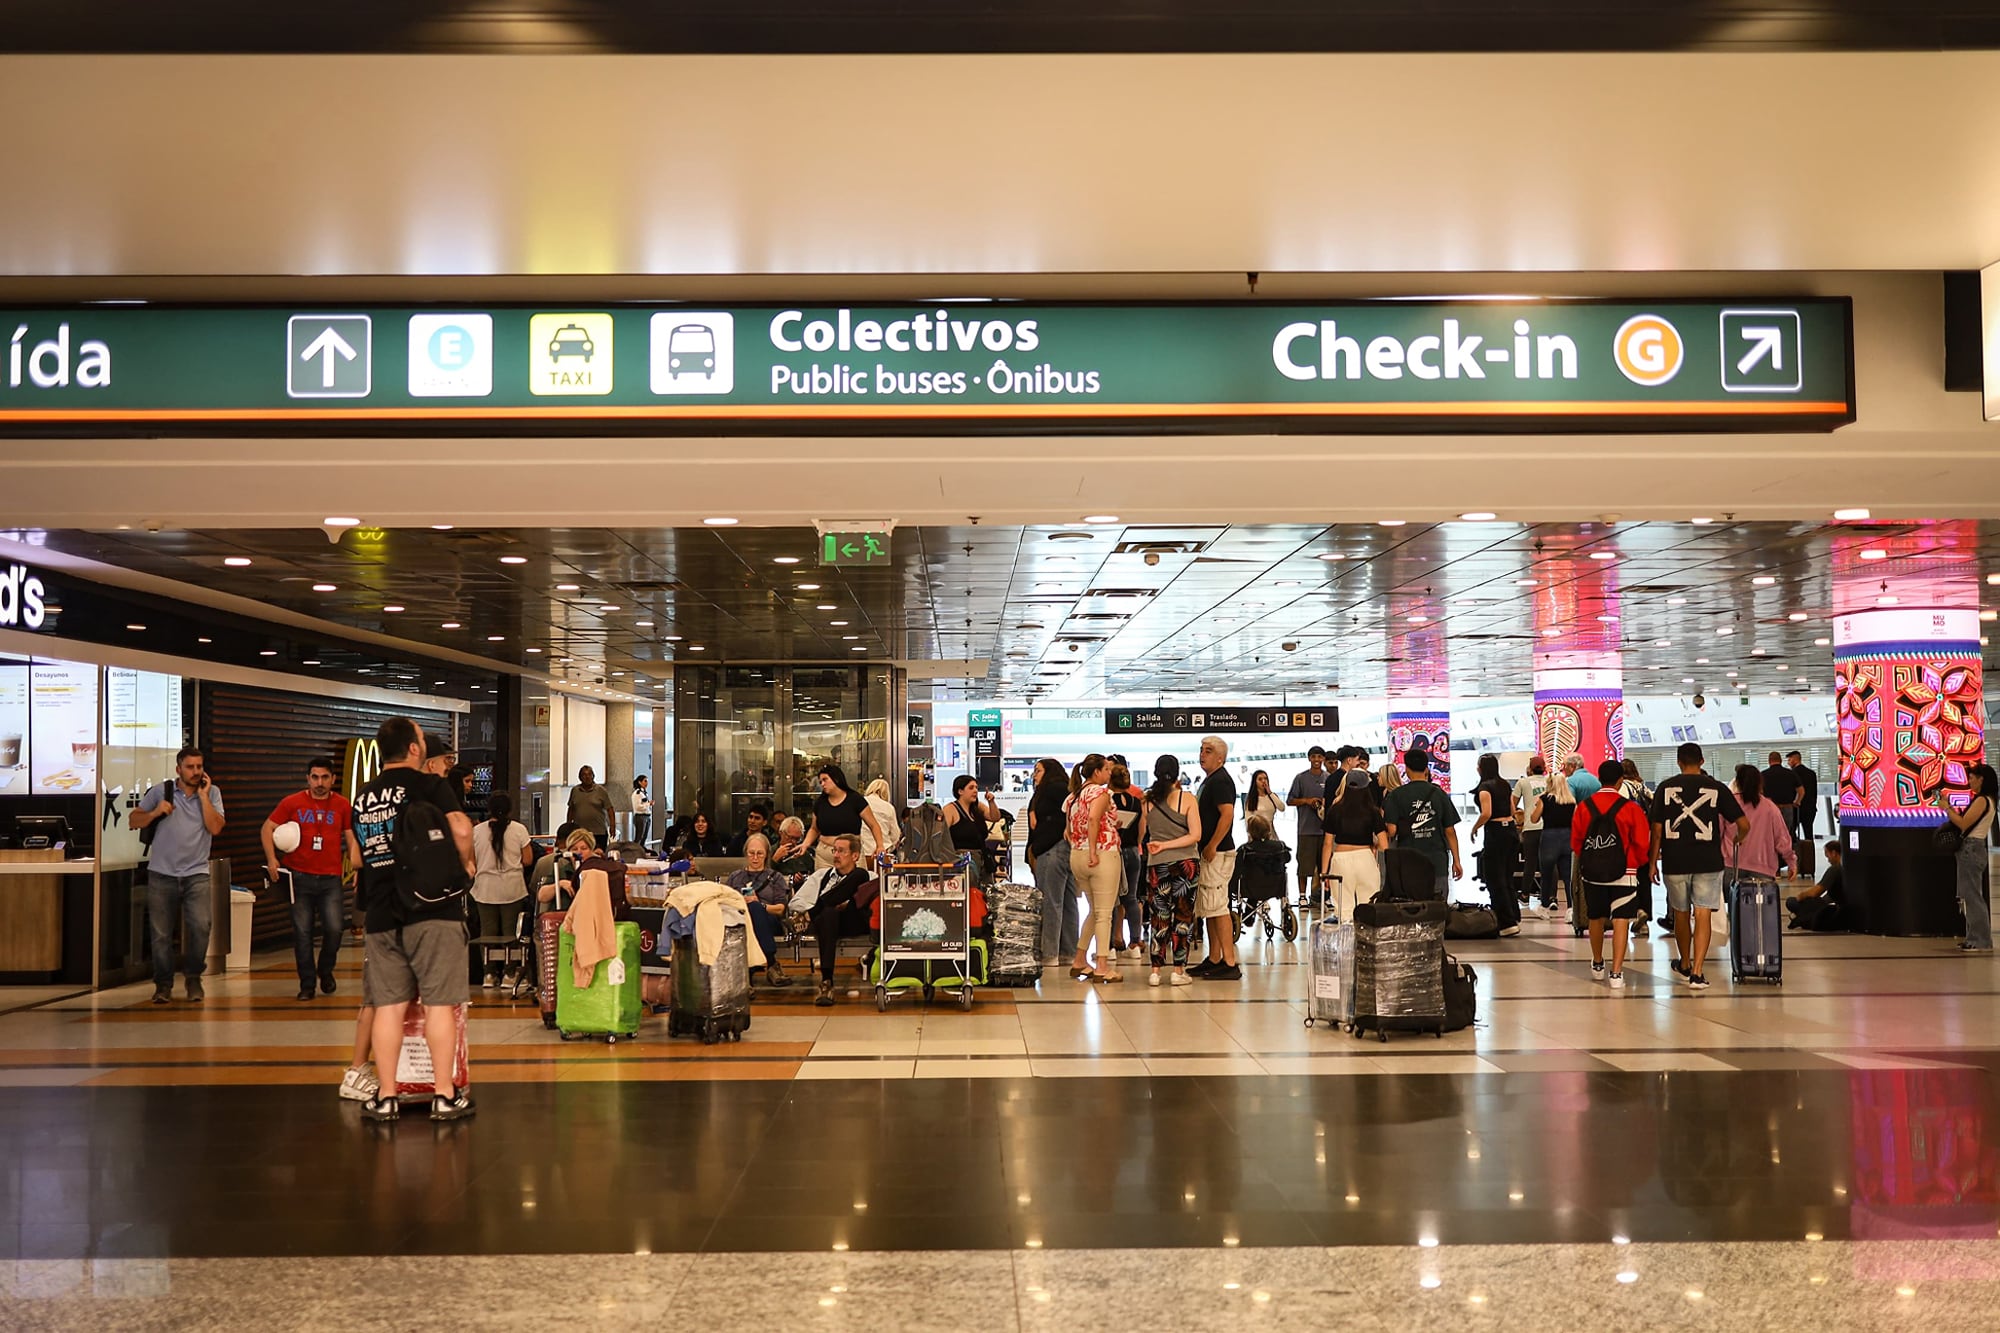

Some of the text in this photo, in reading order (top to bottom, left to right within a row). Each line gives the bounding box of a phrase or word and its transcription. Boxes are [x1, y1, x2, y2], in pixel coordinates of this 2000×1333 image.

[439, 331, 463, 365] E
[769, 308, 1039, 352] Colectivos
[1272, 317, 1578, 381] Check-in
[1627, 328, 1665, 372] G
[10, 324, 111, 388] ída
[549, 371, 592, 385] TAXI
[771, 359, 1101, 395] Public buses Ônibus
